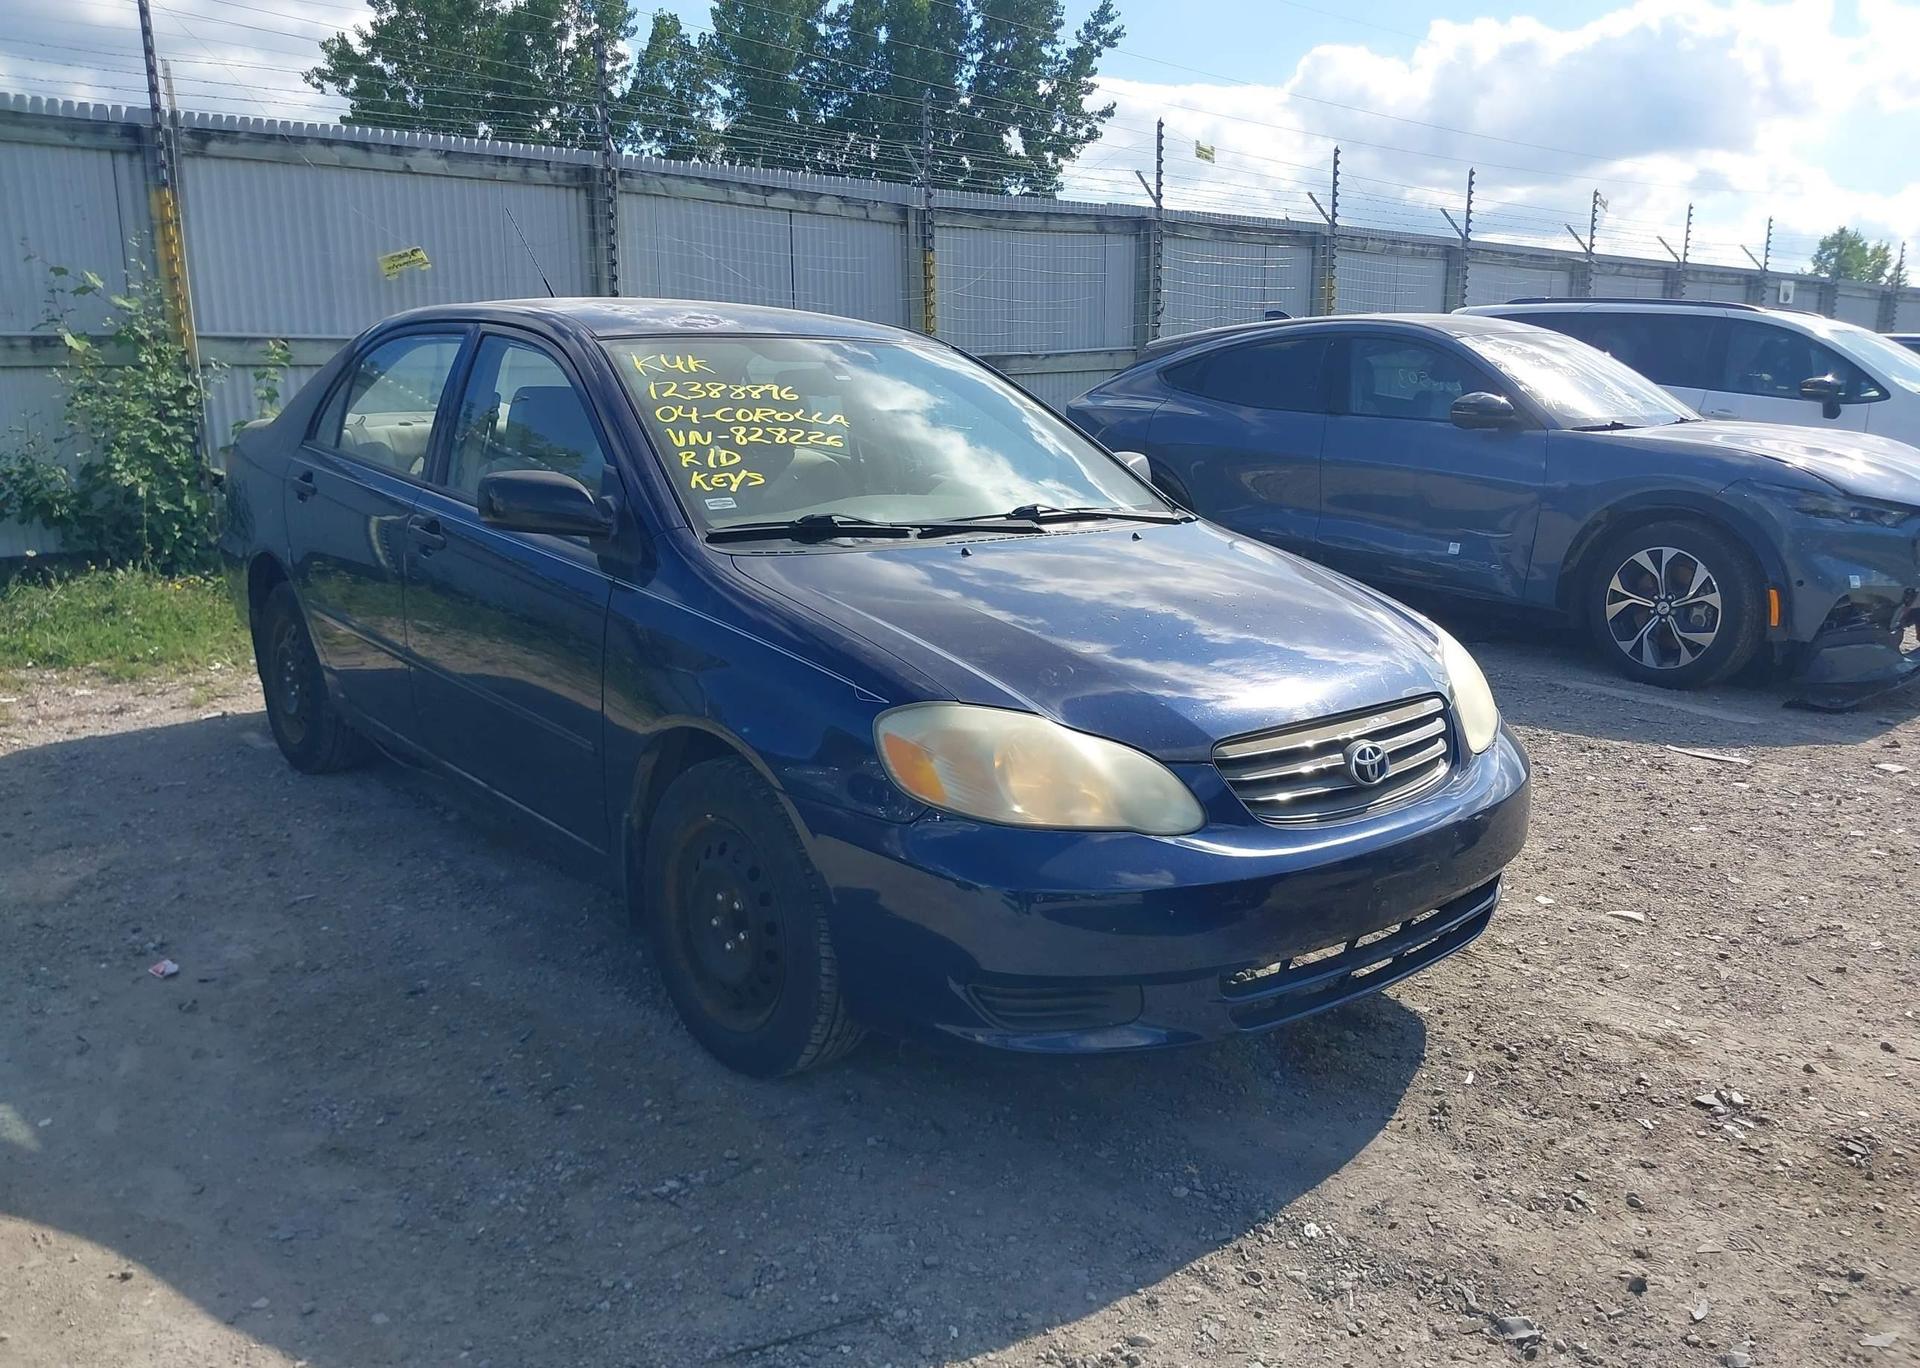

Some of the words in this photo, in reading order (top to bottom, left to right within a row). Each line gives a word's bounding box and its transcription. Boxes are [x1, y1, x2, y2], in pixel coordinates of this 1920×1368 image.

[649, 381, 799, 400] 12388896
[656, 405, 850, 428] 04-COROLLA
[691, 469, 765, 492] KEYS
